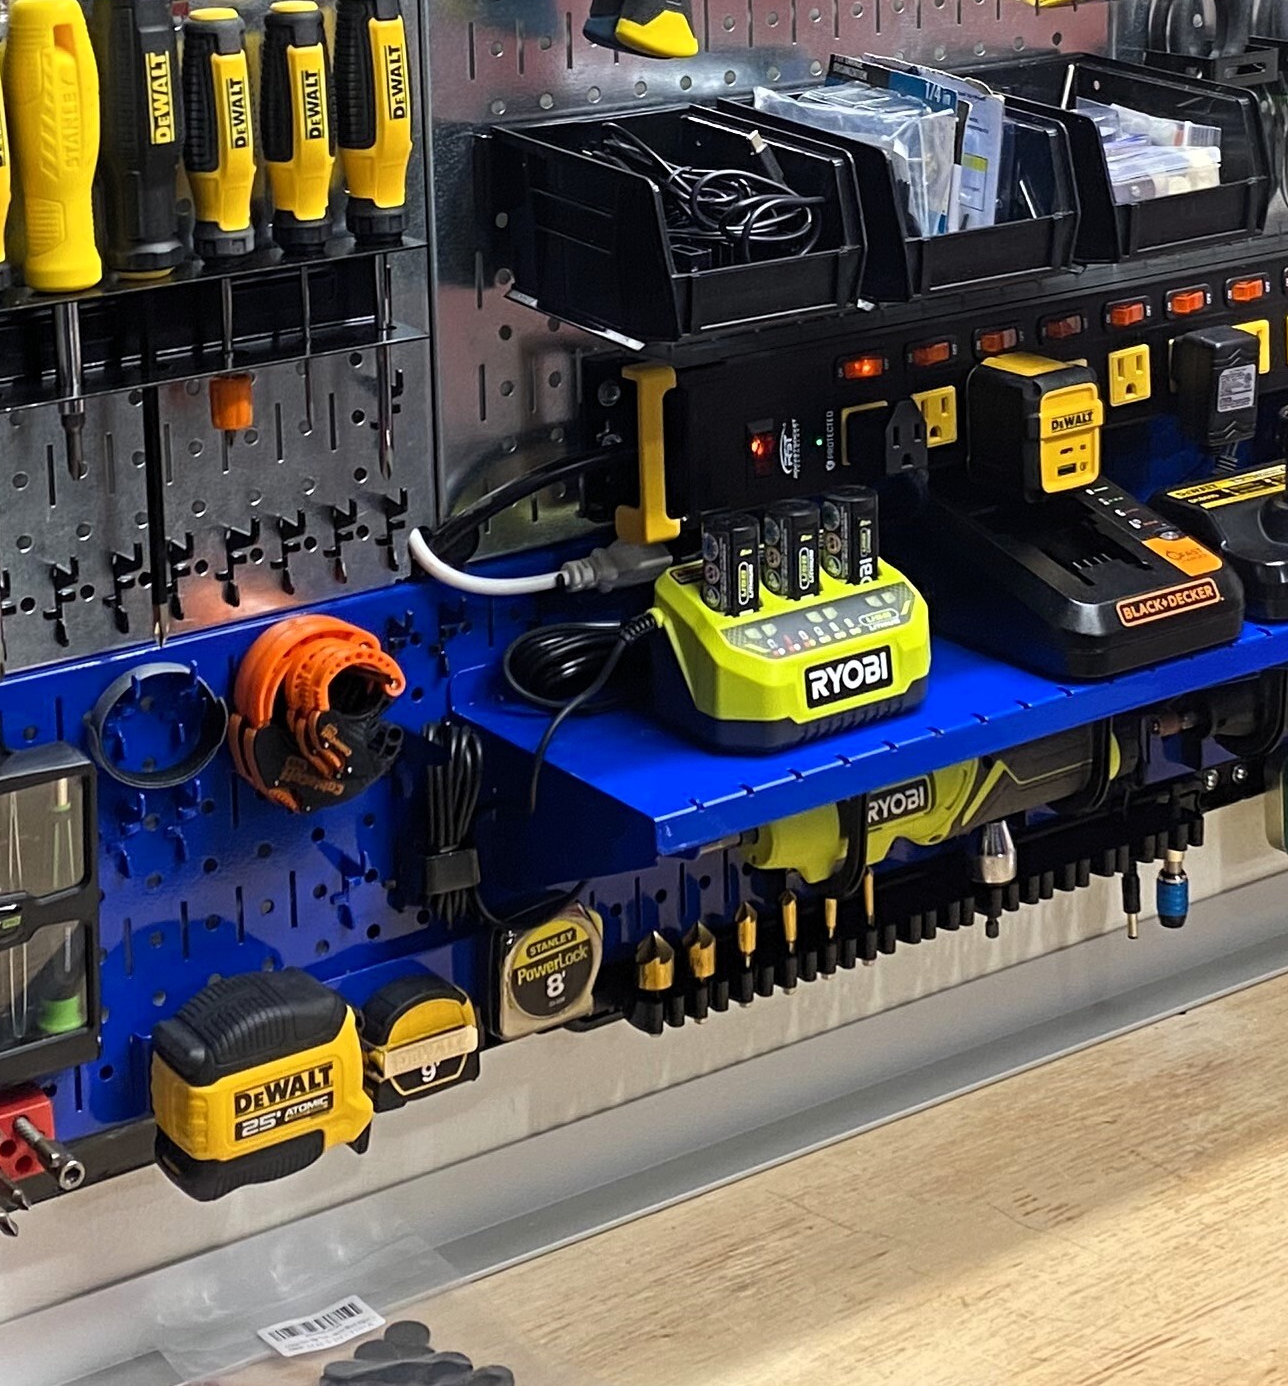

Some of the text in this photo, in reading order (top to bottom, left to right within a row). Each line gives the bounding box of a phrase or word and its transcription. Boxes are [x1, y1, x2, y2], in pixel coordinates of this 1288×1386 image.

[147, 51, 174, 143] DEWALT
[304, 69, 323, 141] DEWALT
[386, 45, 407, 121] DEWALT
[924, 81, 941, 103] 1/4
[230, 77, 249, 149] DEWALT
[826, 411, 834, 460] PROTECTED
[1051, 410, 1093, 432] DEWALT
[1122, 584, 1215, 621] BLACK+DECKER
[809, 652, 888, 701] RYOBI
[867, 786, 925, 824] RYOBI
[529, 929, 575, 956] STANLEY
[546, 971, 567, 999] 8'
[235, 1064, 334, 1115] DEWALT
[241, 1095, 329, 1138] 25' ATOMIC
